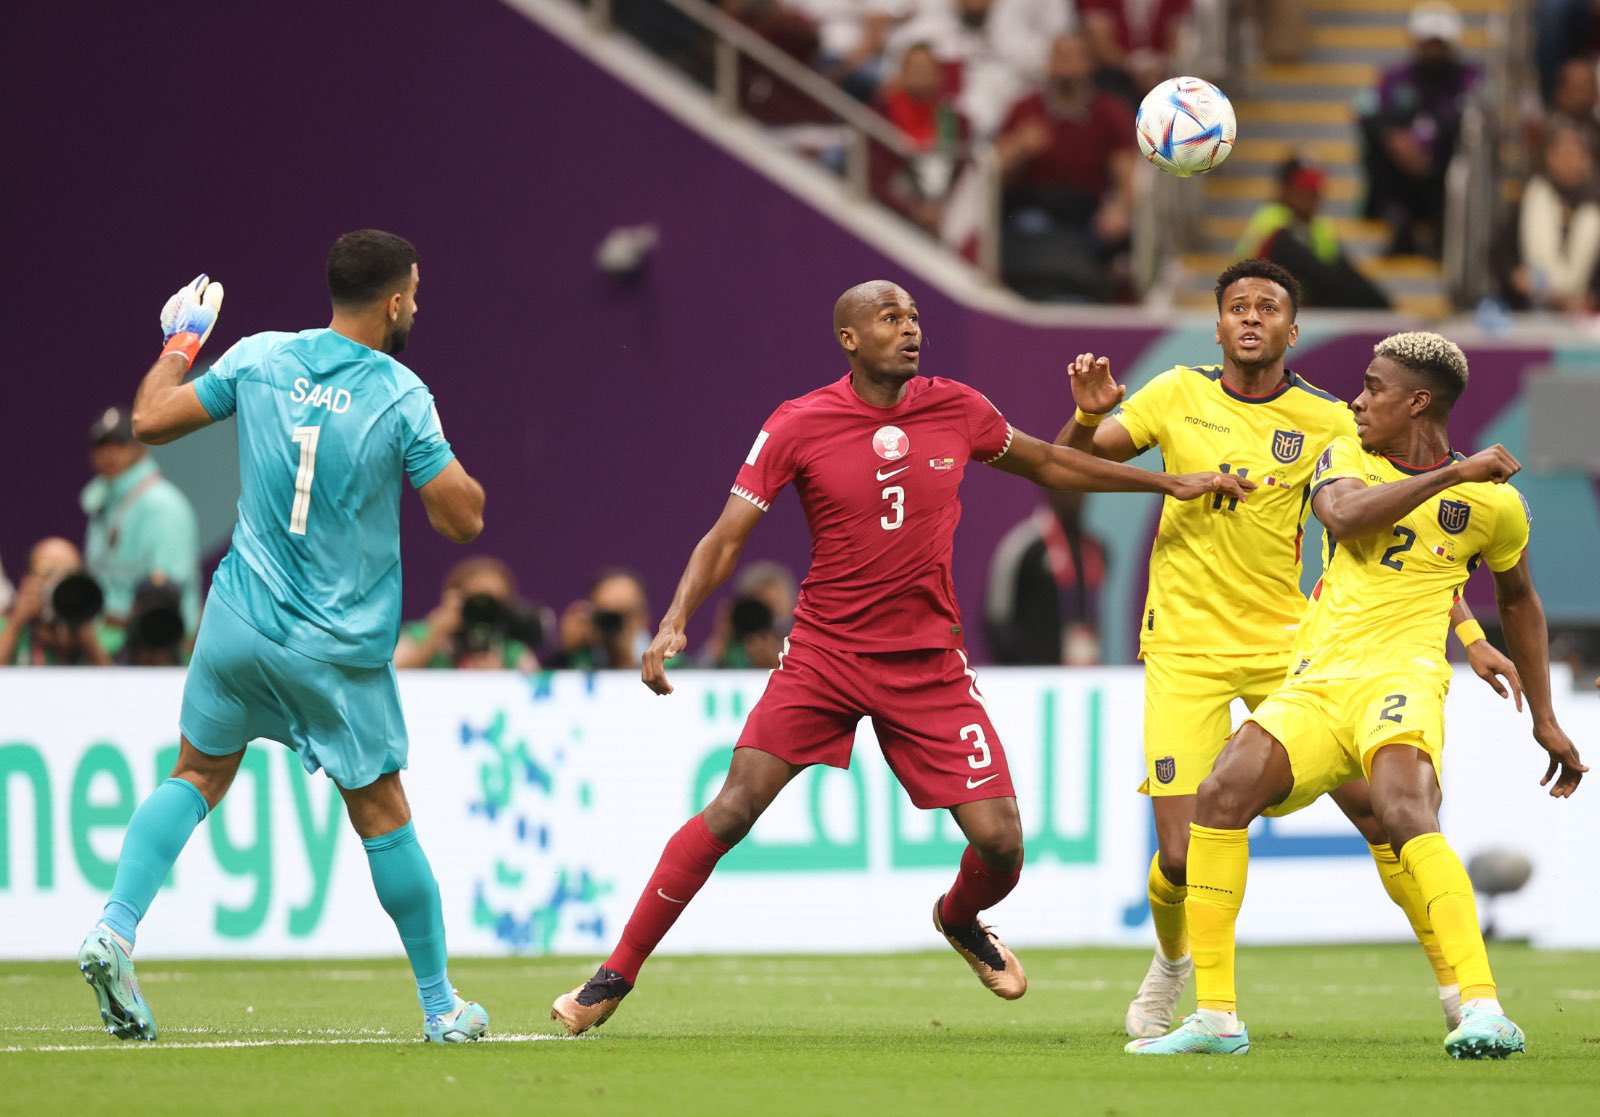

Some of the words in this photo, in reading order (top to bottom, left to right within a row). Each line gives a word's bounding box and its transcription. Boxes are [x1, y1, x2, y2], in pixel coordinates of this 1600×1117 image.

[290, 377, 351, 414] SAAD
[1184, 416, 1230, 433] marathon
[289, 425, 320, 535] 1
[881, 486, 905, 530] 3
[1379, 525, 1414, 573] 2
[1380, 694, 1407, 723] 2
[960, 723, 991, 769] 3
